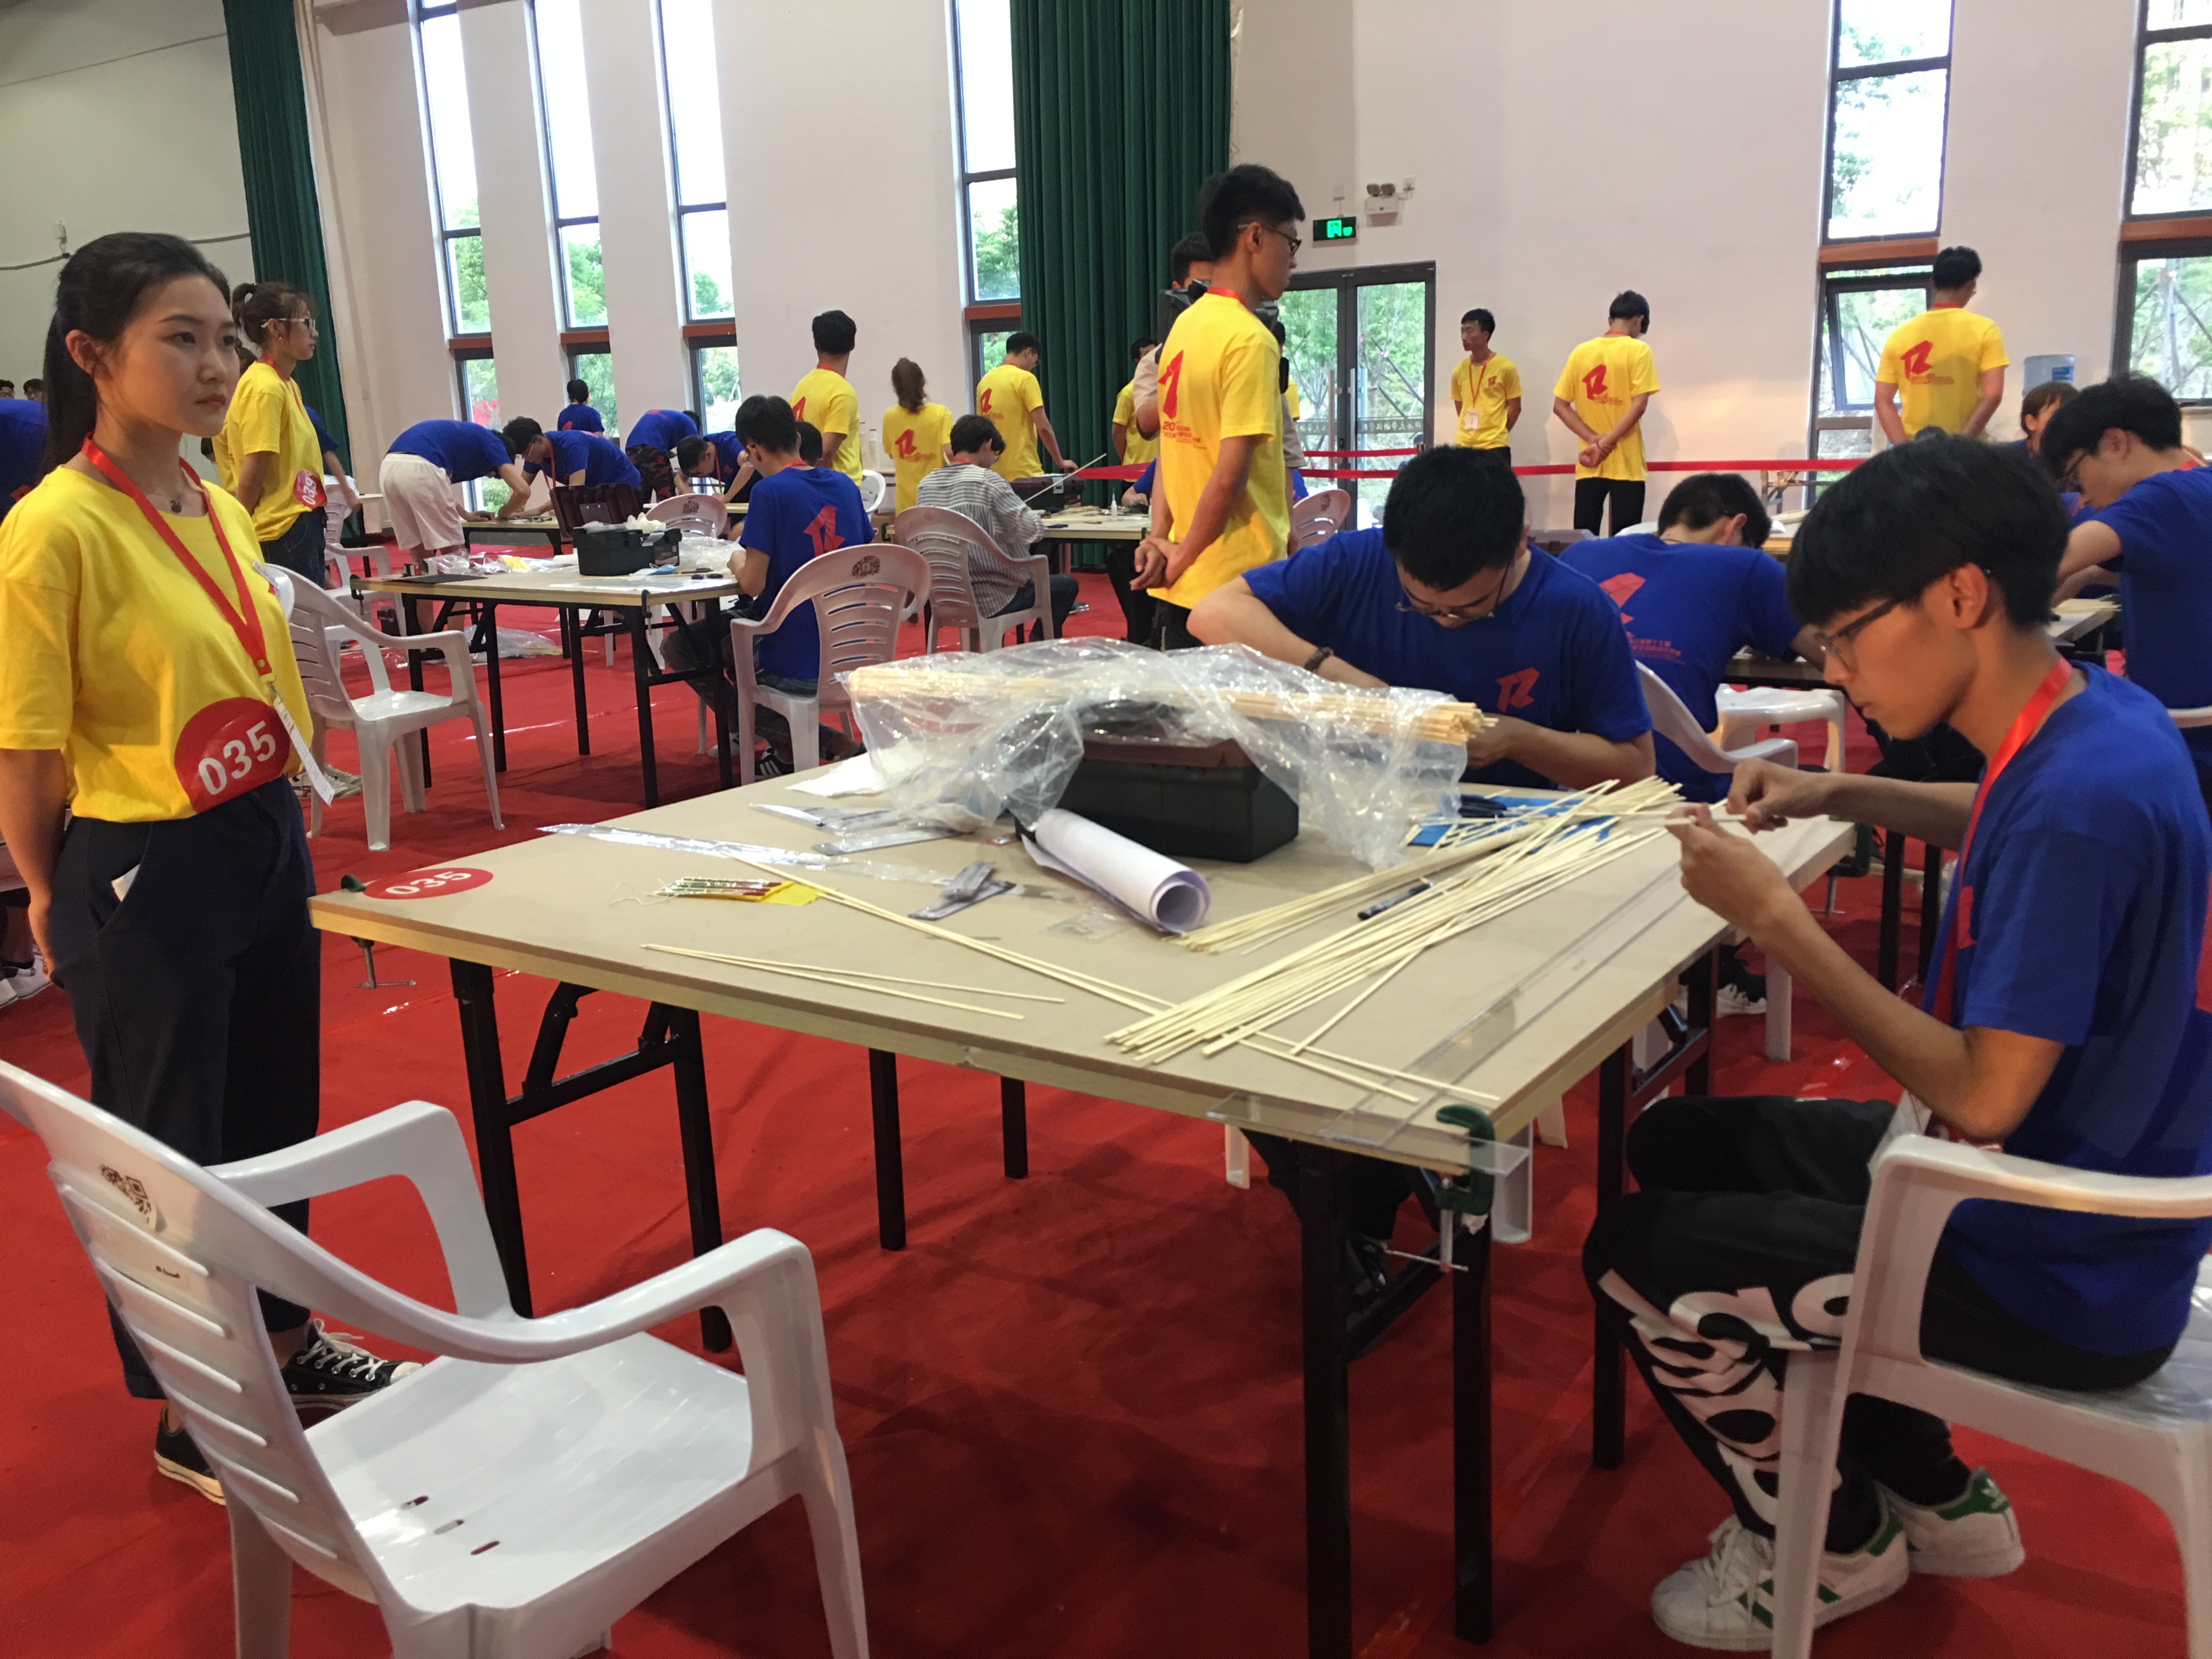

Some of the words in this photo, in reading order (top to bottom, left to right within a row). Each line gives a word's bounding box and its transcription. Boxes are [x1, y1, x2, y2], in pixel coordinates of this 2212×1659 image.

[302, 477, 318, 505] 039
[198, 720, 275, 795] 035
[385, 871, 471, 894] 035
